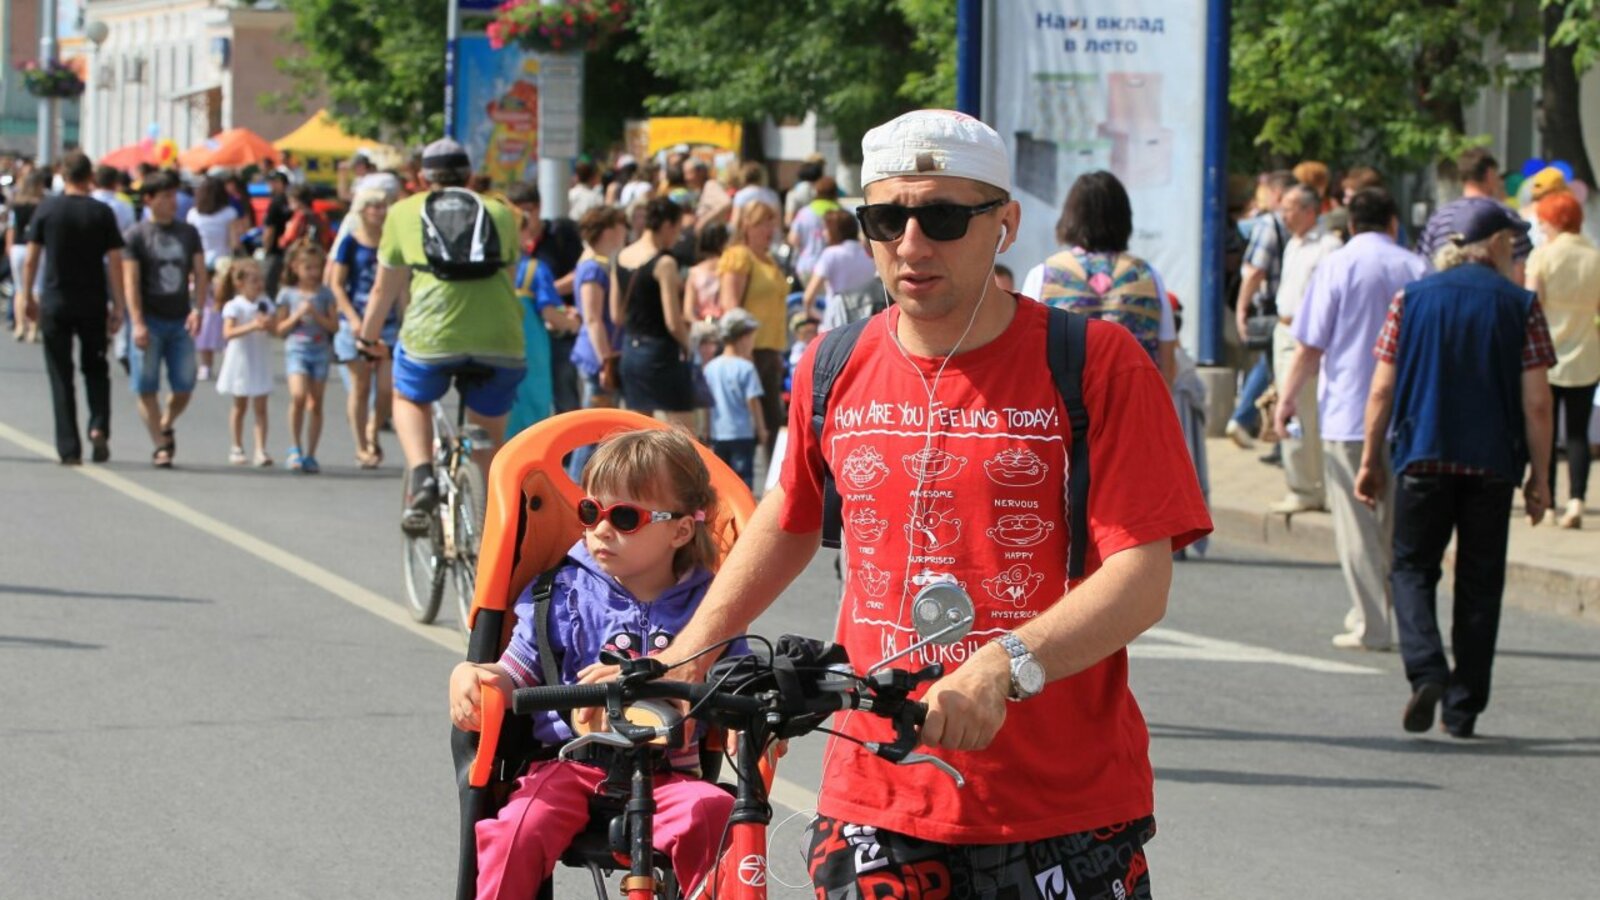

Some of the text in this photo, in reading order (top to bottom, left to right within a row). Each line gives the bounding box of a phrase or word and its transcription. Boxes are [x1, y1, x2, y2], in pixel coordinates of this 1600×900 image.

[1096, 16, 1165, 34] вклад
[1064, 39, 1138, 54] в лето
[835, 404, 866, 430] HOW
[865, 399, 896, 425] ARE
[897, 400, 924, 427] YOU
[929, 400, 998, 429] FEELING
[909, 489, 954, 499] AWESOME
[994, 498, 1039, 509] NERVOUS
[908, 555, 956, 565] SURPRISED
[1004, 551, 1034, 560] HAPPY
[991, 610, 1040, 619] HYSTERICA
